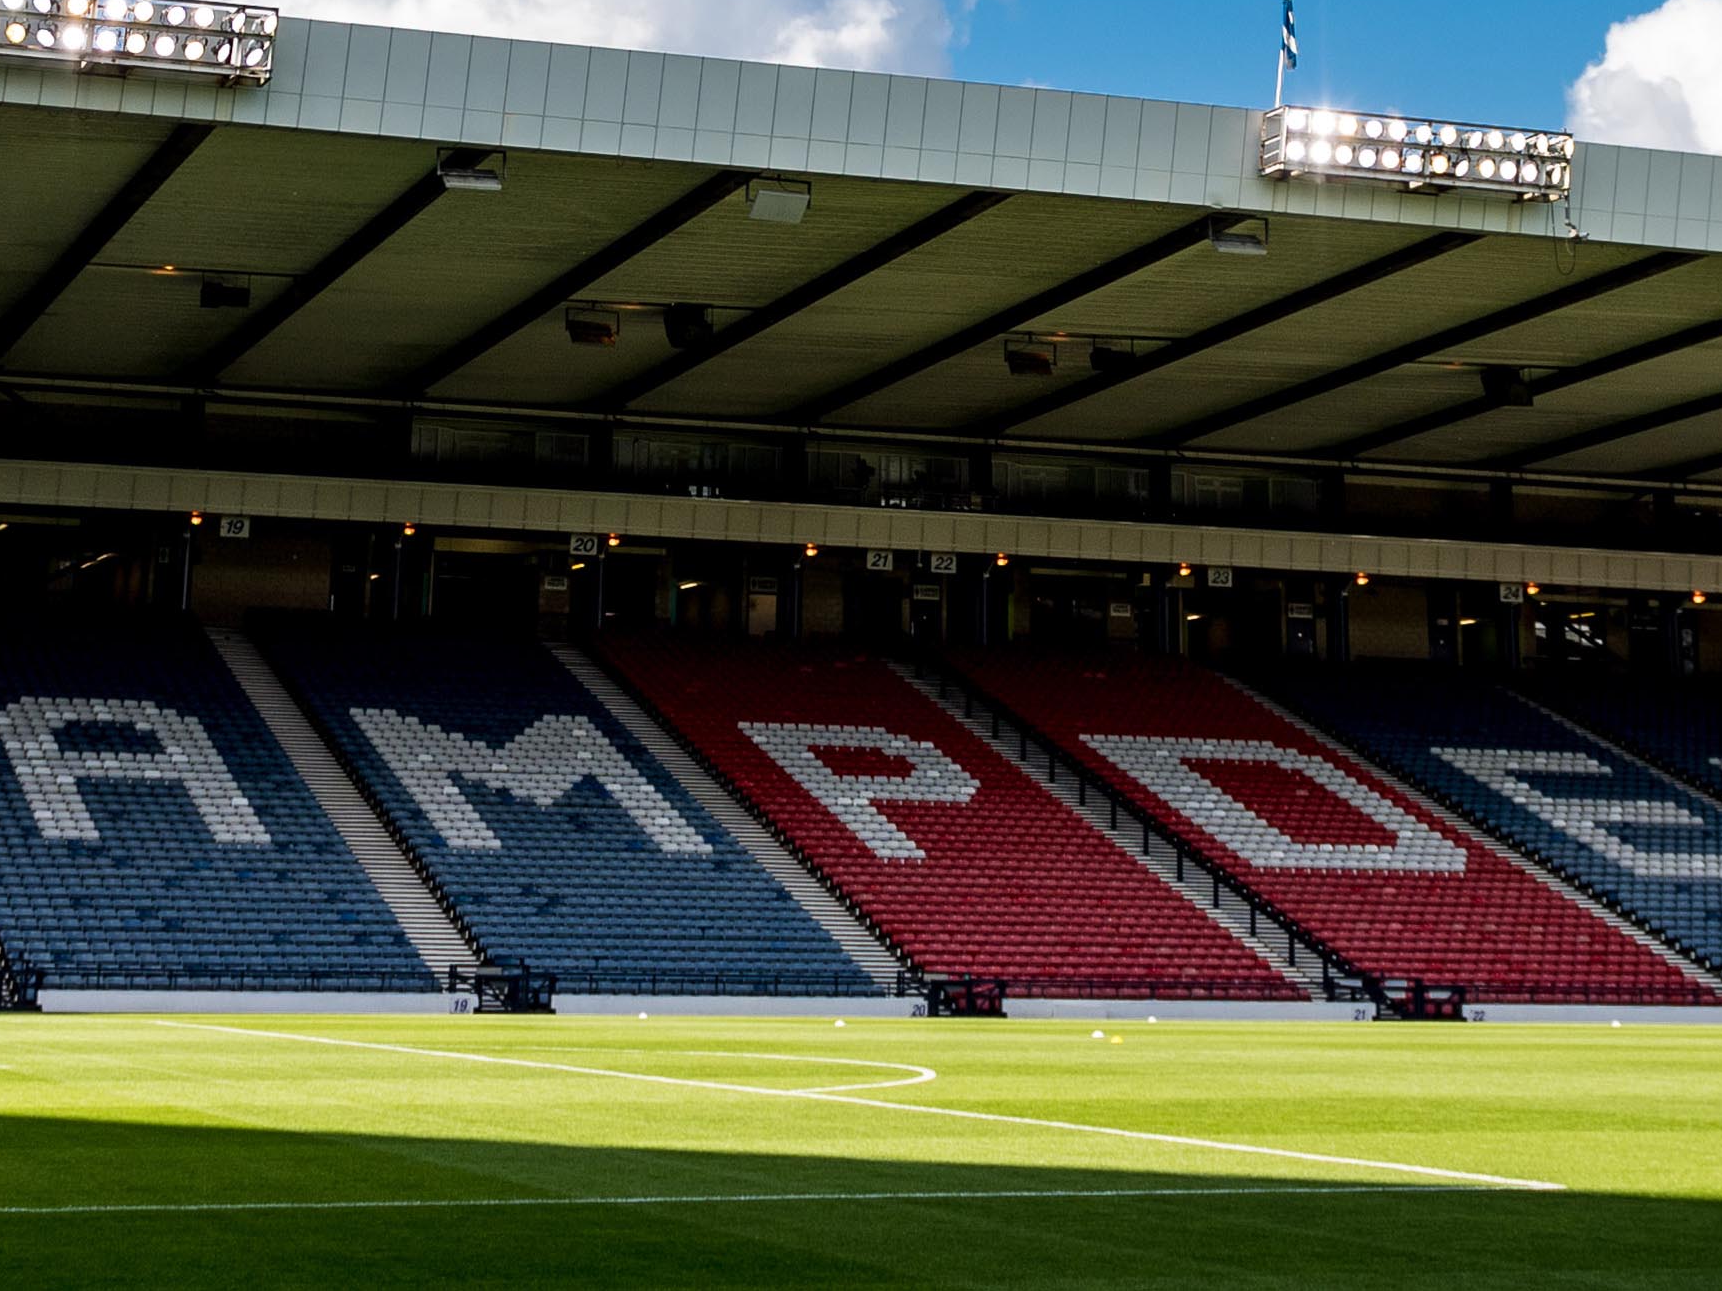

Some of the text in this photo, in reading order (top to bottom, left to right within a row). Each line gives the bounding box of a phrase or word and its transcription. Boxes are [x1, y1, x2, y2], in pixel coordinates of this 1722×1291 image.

[227, 519, 245, 535] 19
[573, 537, 595, 552] 20
[871, 553, 888, 567] 21
[934, 556, 954, 571] 22
[1212, 571, 1230, 584] 23
[1502, 586, 1521, 599] 24
[454, 999, 468, 1013] 19
[912, 1004, 926, 1017] 20
[1354, 1009, 1366, 1021] 21
[1473, 1010, 1485, 1022] 22
